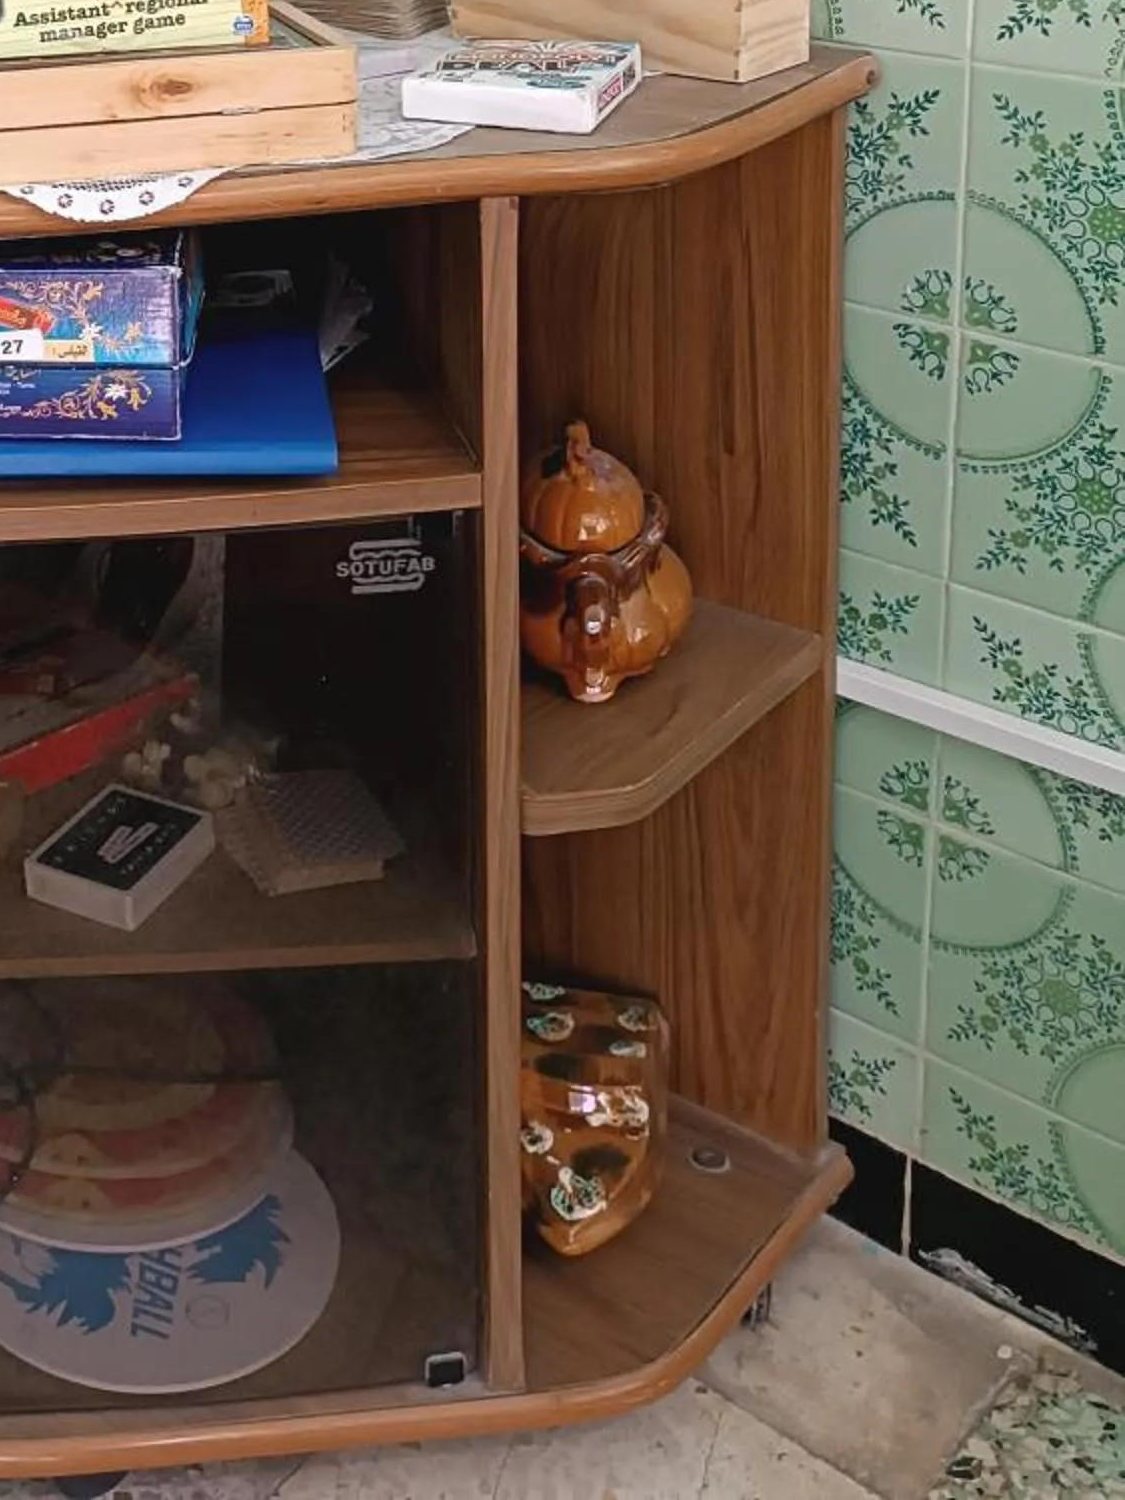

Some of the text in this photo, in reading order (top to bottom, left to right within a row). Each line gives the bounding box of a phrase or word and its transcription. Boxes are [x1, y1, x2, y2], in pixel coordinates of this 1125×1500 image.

[13, 2, 111, 27] Assistant
[39, 14, 186, 43] manager game
[1, 339, 24, 354] 27
[336, 556, 435, 577] SOTUFAB
